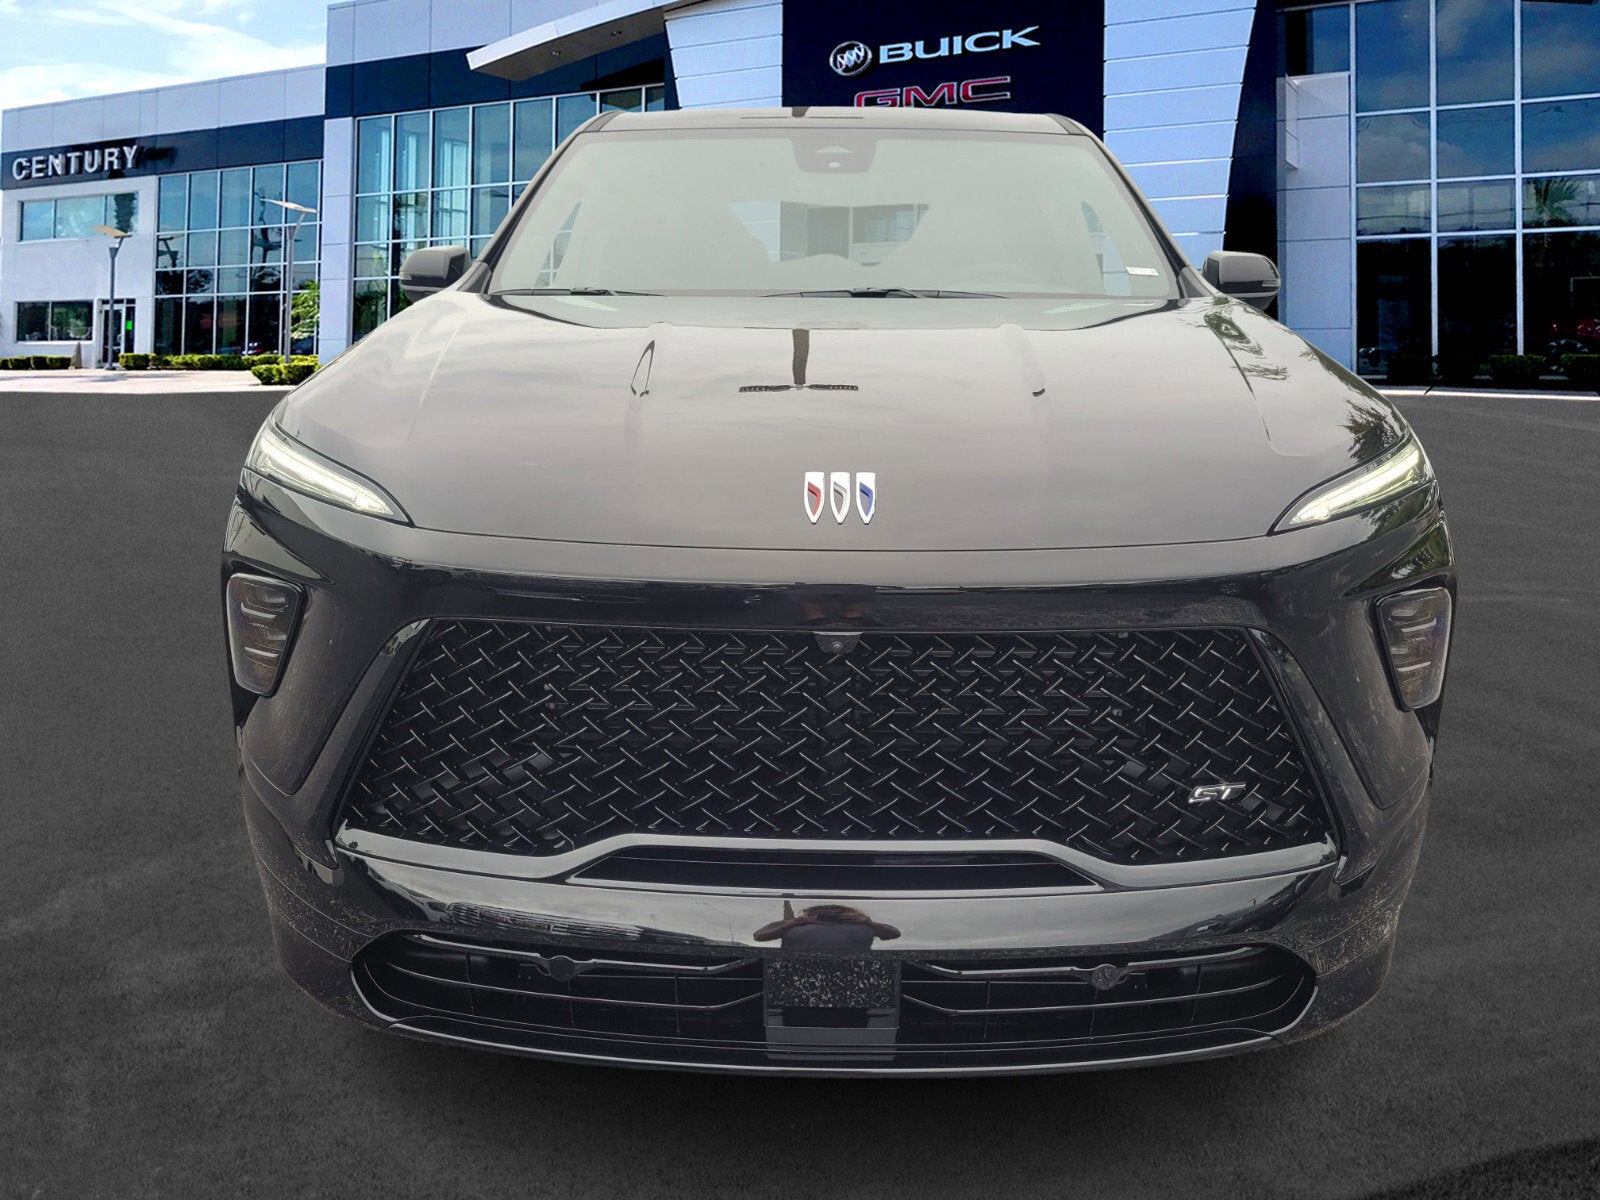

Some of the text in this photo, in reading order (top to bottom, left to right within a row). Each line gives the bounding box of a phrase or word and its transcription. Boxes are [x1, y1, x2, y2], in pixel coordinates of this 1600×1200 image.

[879, 25, 1041, 64] BUICK
[854, 76, 1011, 108] GMC
[12, 145, 138, 180] CENTURY
